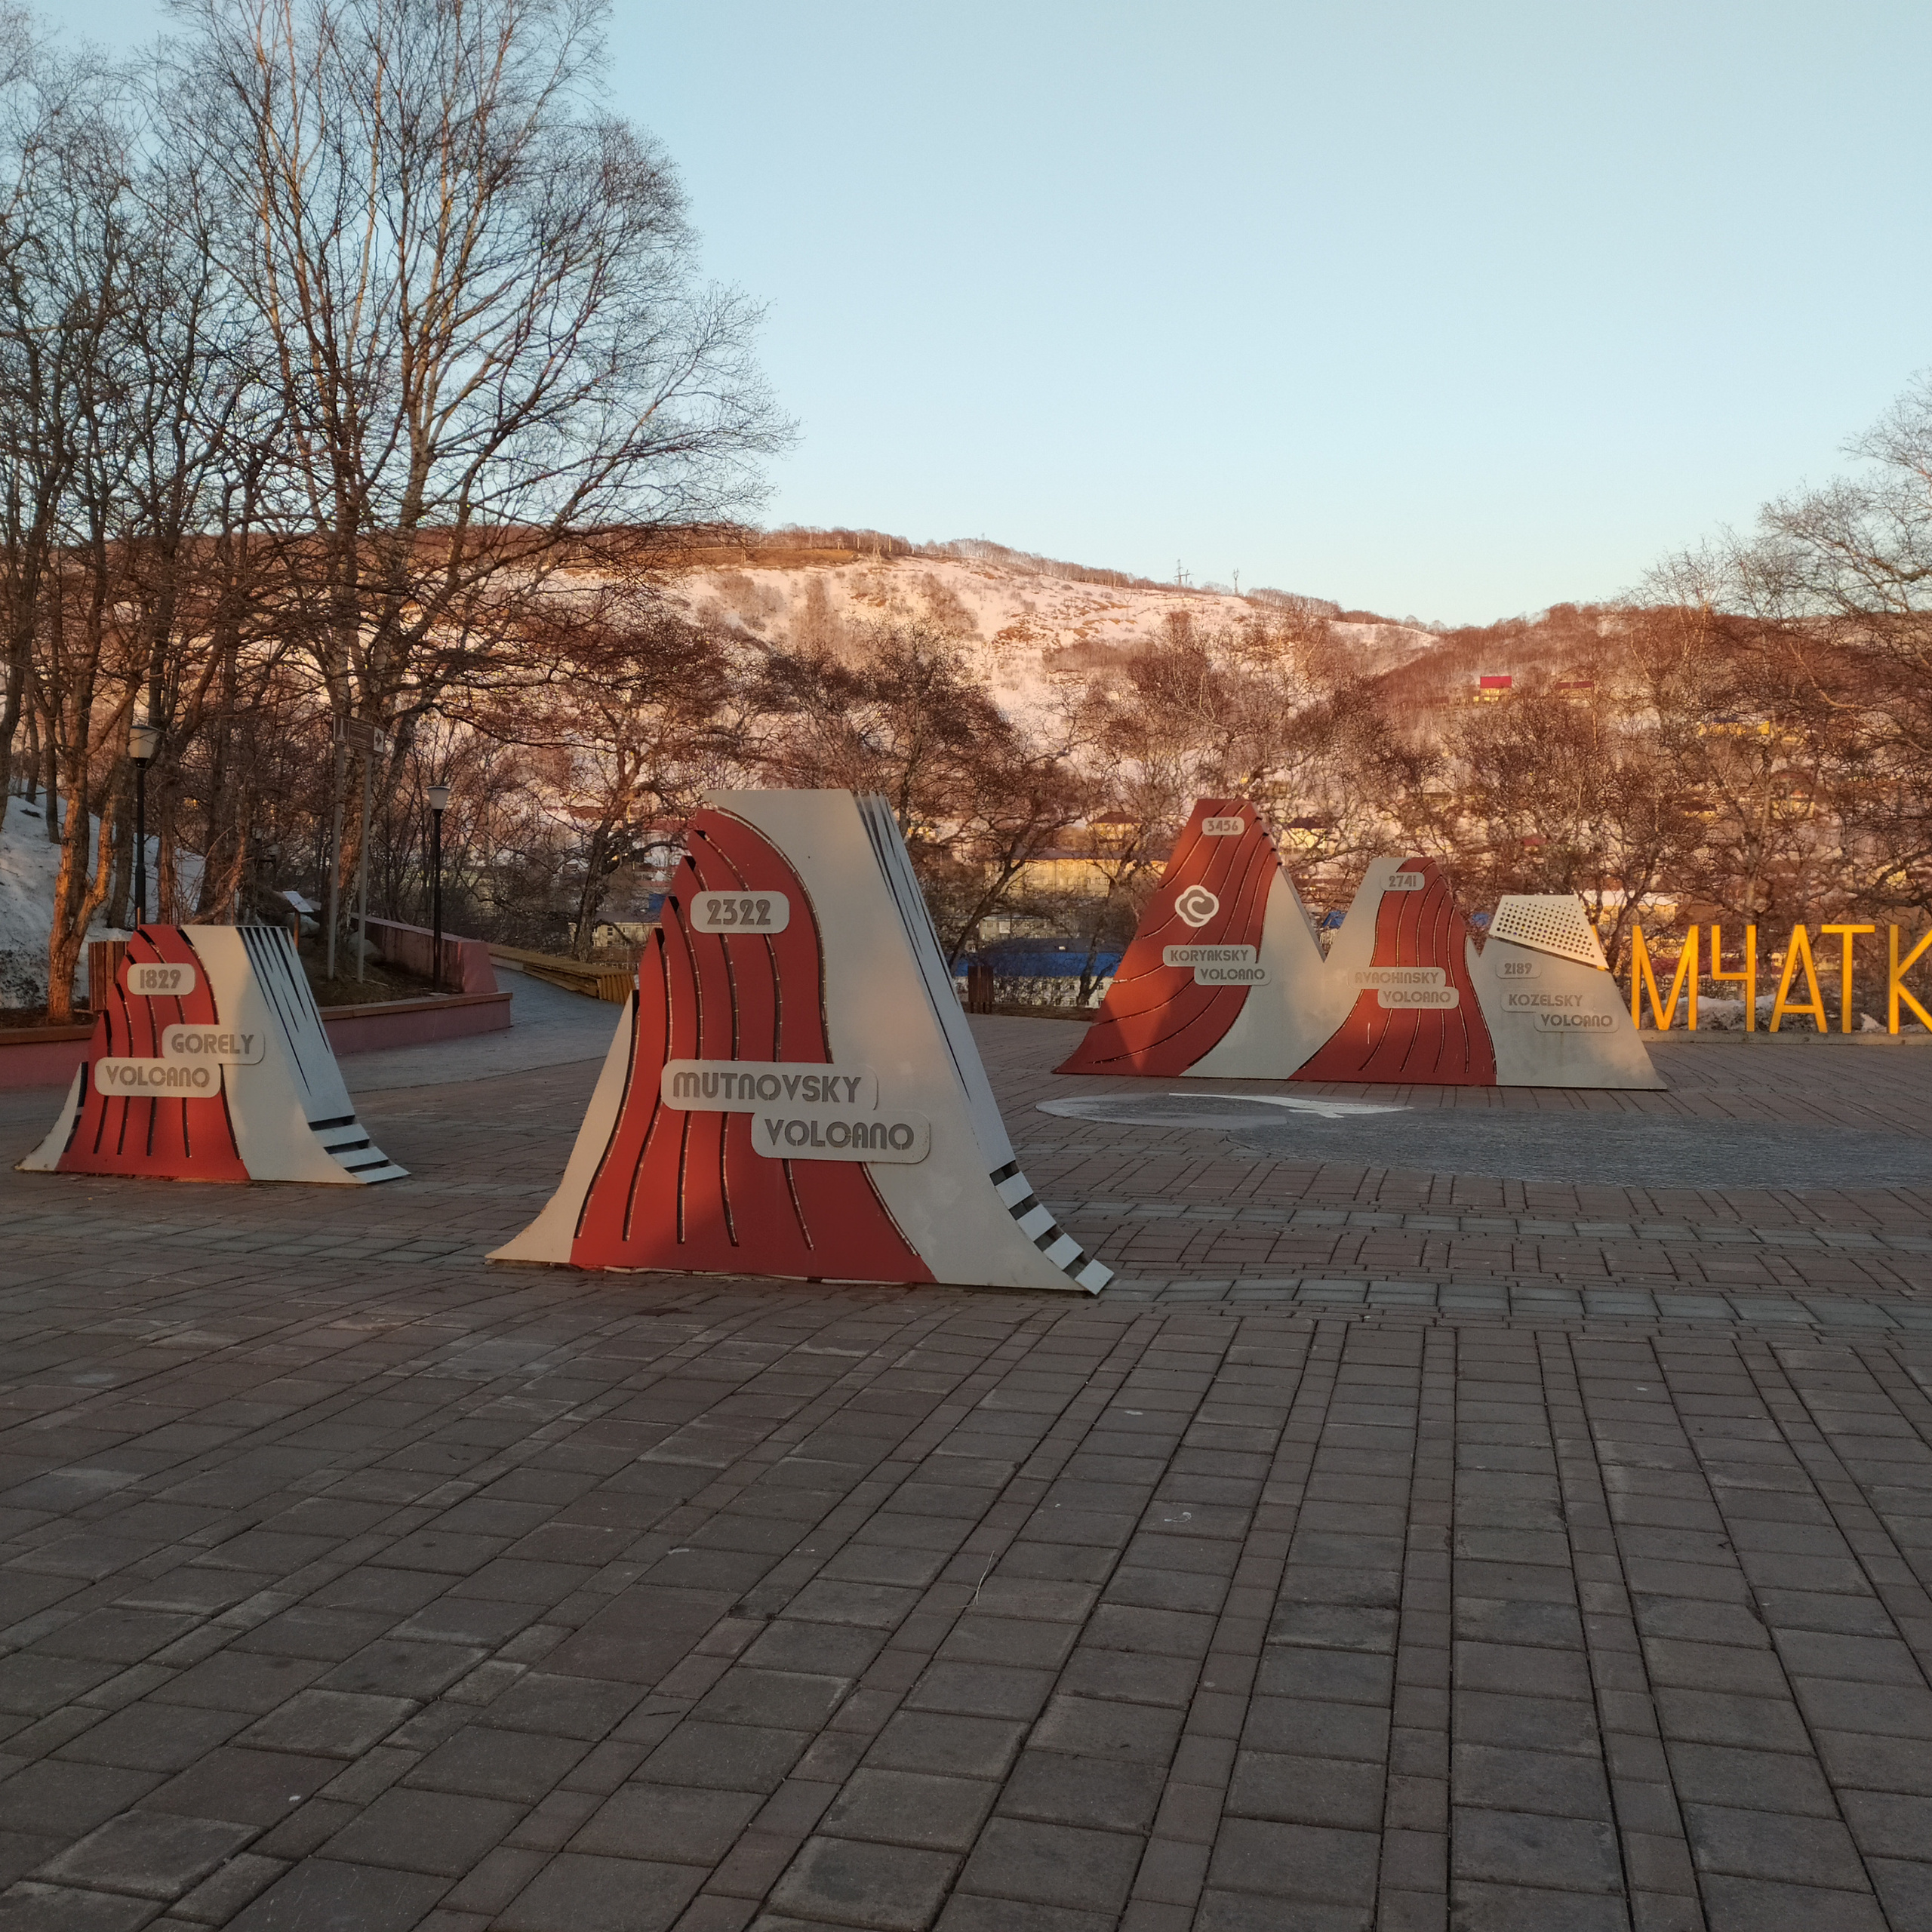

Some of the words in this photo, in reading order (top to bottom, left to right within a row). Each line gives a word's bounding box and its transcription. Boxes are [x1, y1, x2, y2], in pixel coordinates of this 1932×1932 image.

[1208, 820, 1238, 832] 3456
[1388, 875, 1417, 888] 2741
[706, 899, 771, 926] 2322
[1170, 949, 1249, 962] KORYAKSKY
[1200, 968, 1266, 981] VOLCANO
[1503, 962, 1533, 975] 2189
[139, 969, 182, 989] 1829
[1355, 971, 1440, 985] AVACHINSKY
[1591, 924, 1932, 1034] МЧАТК
[1382, 990, 1452, 1004] VOLCANO
[1508, 993, 1584, 1008] KOZELSKY
[1540, 1014, 1614, 1028] VOLCANO
[171, 1032, 255, 1055] GORELY
[105, 1065, 211, 1088] VOLCANO
[672, 1071, 863, 1104] MUTNOVSKY
[764, 1118, 915, 1151] VOLCANO
